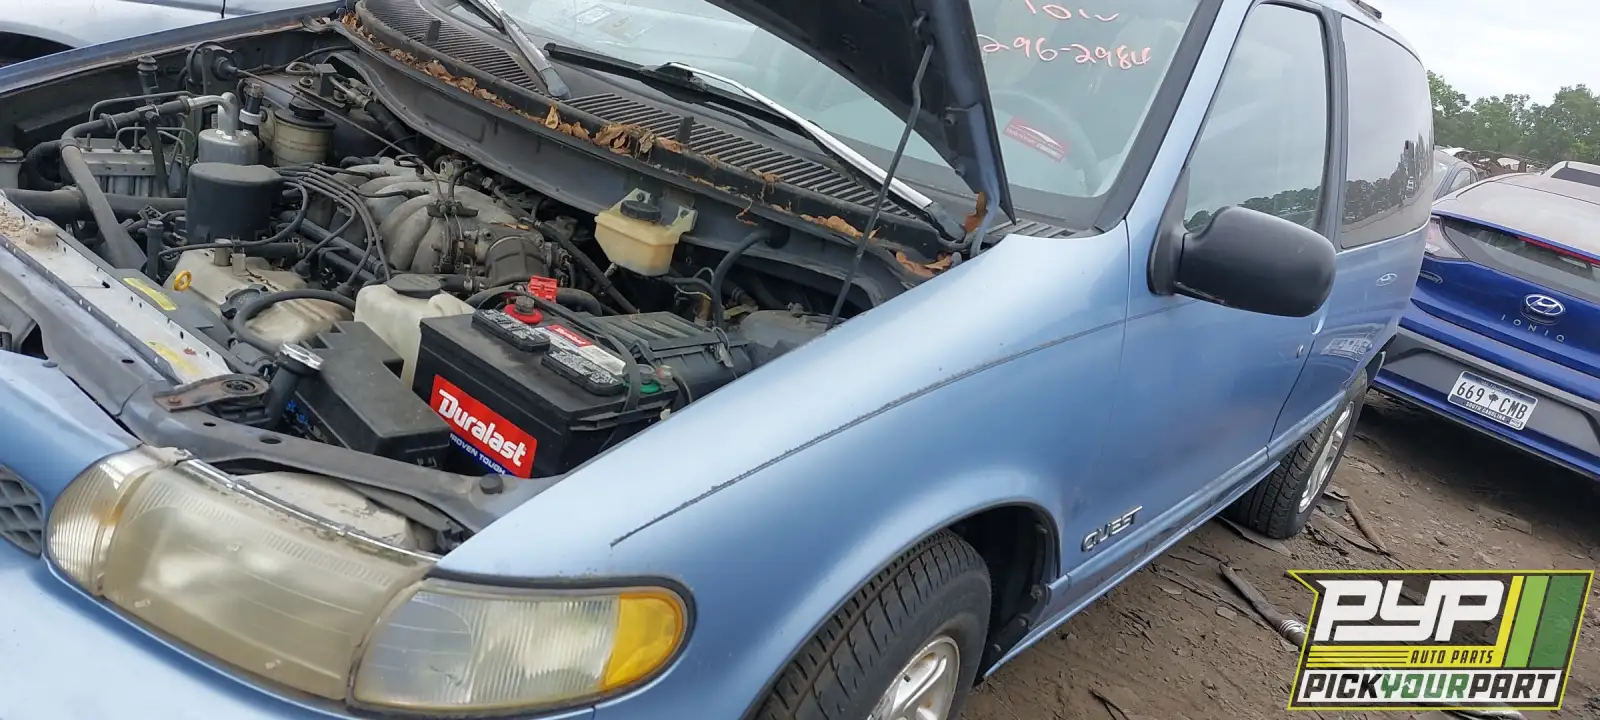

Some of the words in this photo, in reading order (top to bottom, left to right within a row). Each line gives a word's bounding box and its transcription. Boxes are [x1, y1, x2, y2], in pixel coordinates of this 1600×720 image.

[1501, 314, 1565, 343] IONIQ
[1456, 381, 1486, 403] 669
[1498, 397, 1528, 420] CMB
[1465, 401, 1482, 413] SOUTH
[1481, 407, 1506, 421] CAROLINA
[438, 388, 527, 467] Duralast
[1081, 505, 1143, 552] QUEST
